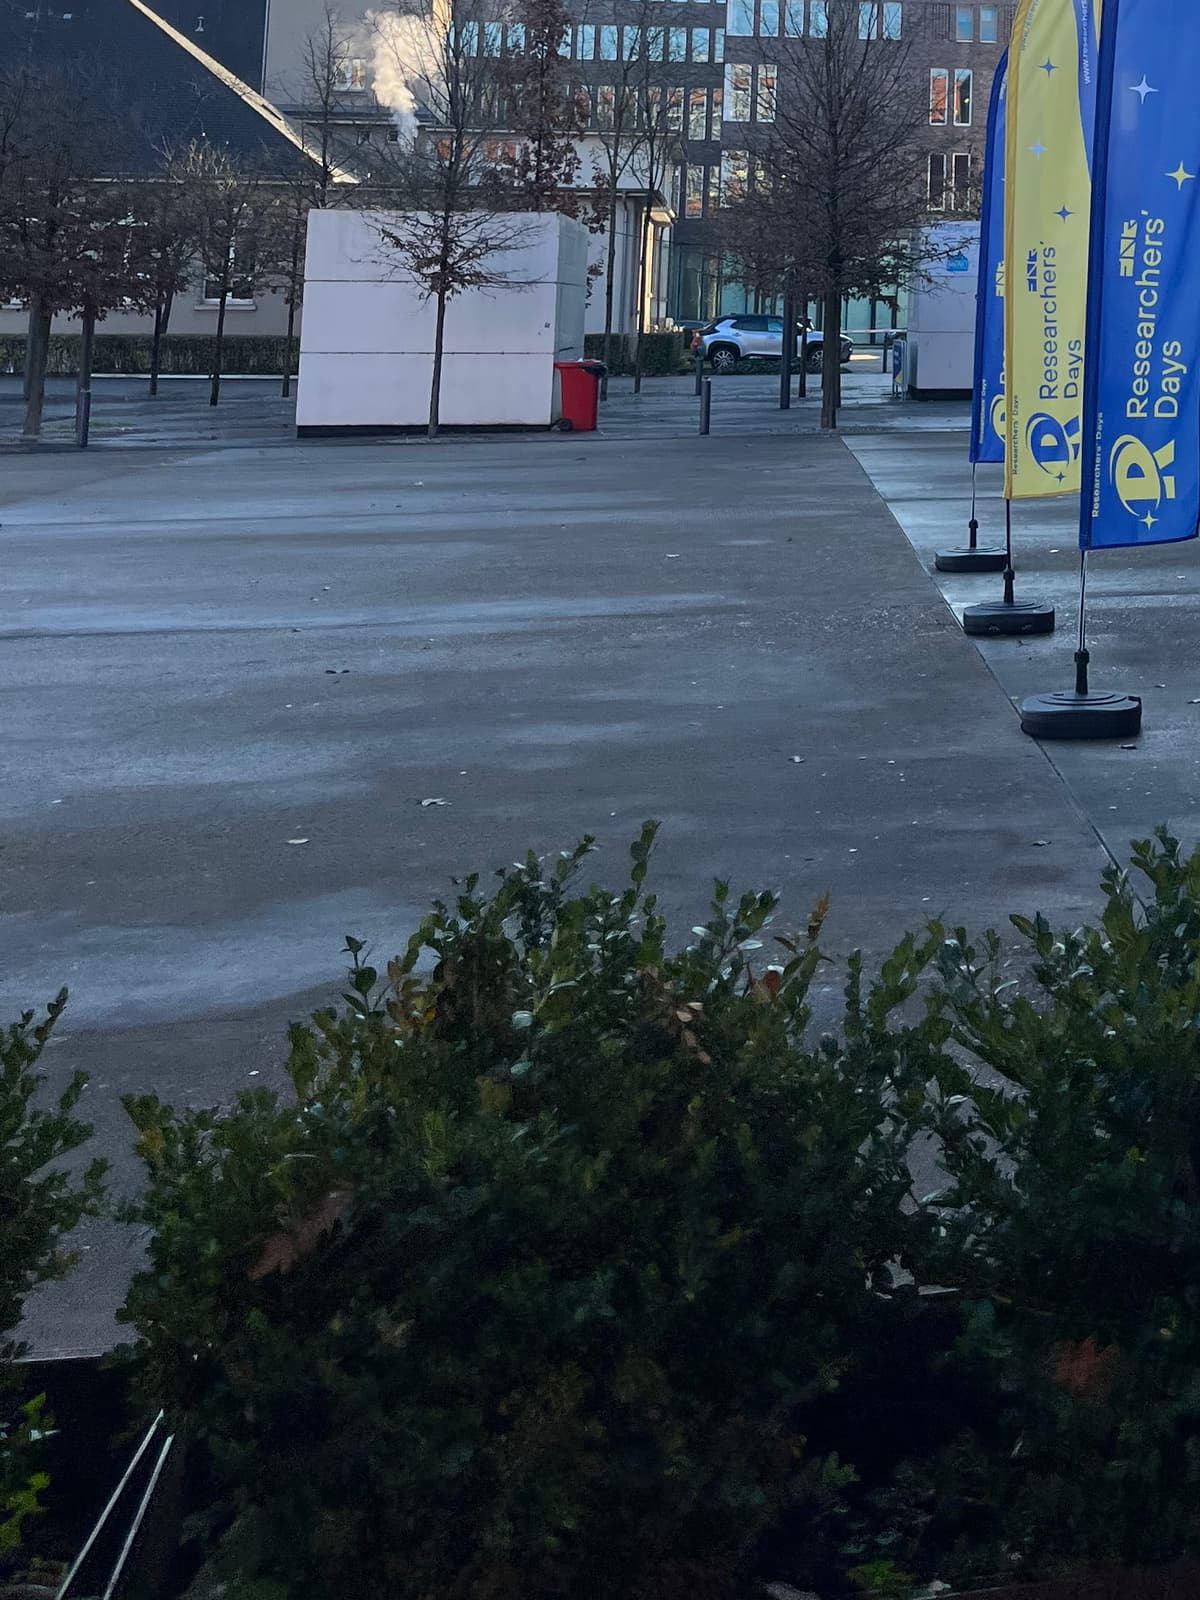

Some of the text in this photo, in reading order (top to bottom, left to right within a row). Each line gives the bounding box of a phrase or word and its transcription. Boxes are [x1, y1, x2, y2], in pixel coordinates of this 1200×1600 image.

[1039, 240, 1058, 400] Researchers'
[1063, 339, 1084, 399] Days
[1126, 209, 1165, 419] Researchers'
[1154, 340, 1187, 419] Days
